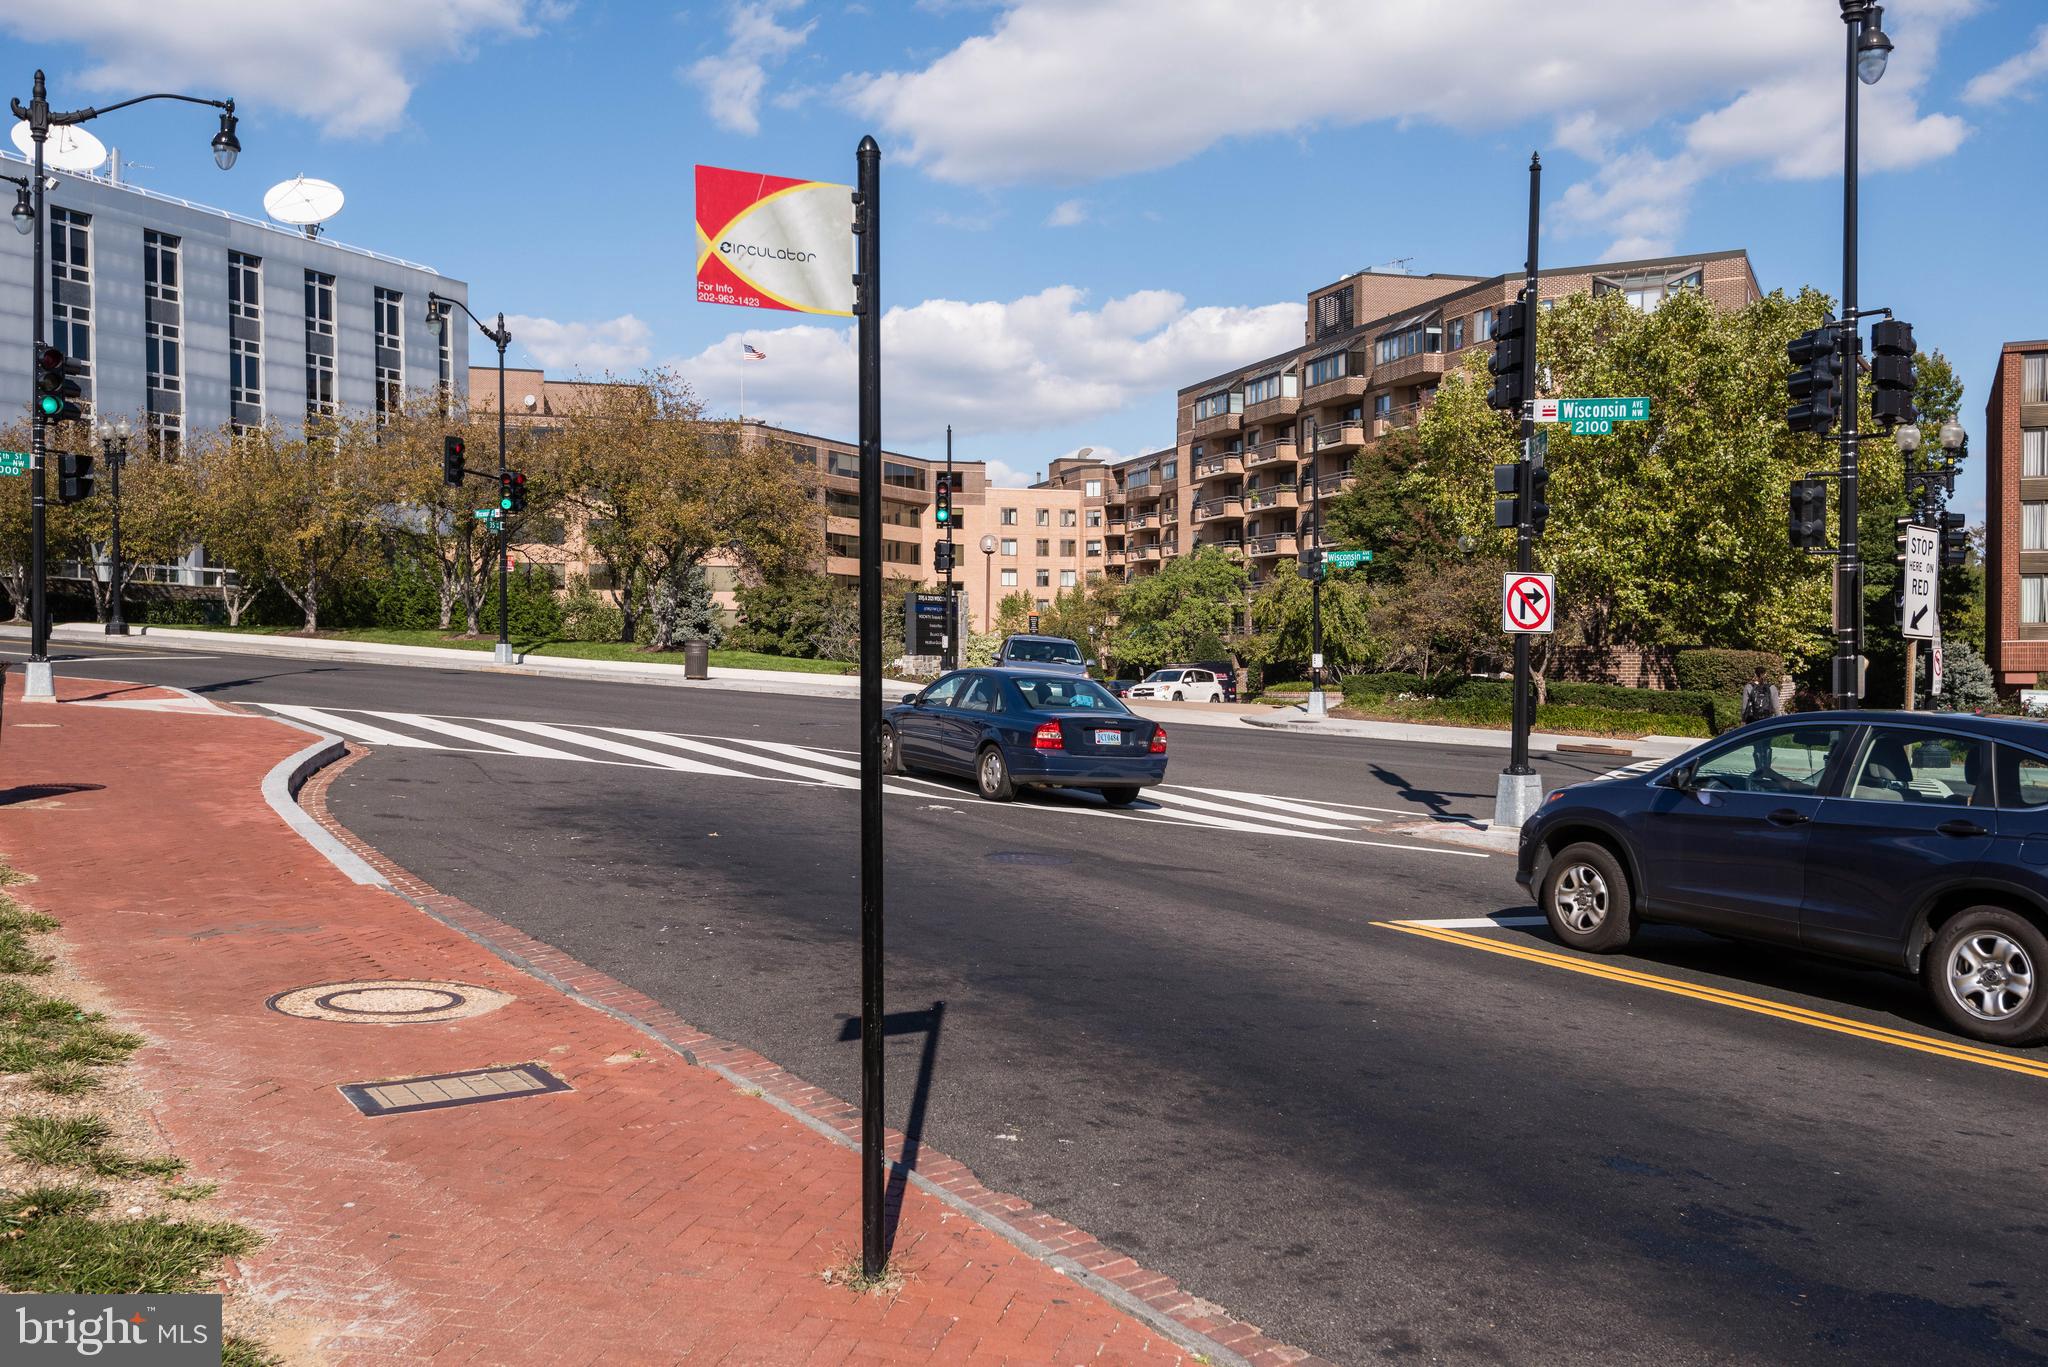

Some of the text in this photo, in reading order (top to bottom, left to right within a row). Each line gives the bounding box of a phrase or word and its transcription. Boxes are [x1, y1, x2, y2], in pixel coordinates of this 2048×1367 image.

[698, 281, 733, 294] For Info
[698, 292, 760, 307] 202-962-1423
[1563, 401, 1627, 419] Wisconsin
[1632, 409, 1643, 417] NW
[1575, 420, 1609, 433] 2100
[1911, 537, 1934, 557] STOP
[1328, 552, 1360, 561] Wisconsin
[1909, 561, 1934, 573] HERE ON
[1912, 578, 1929, 596] RED
